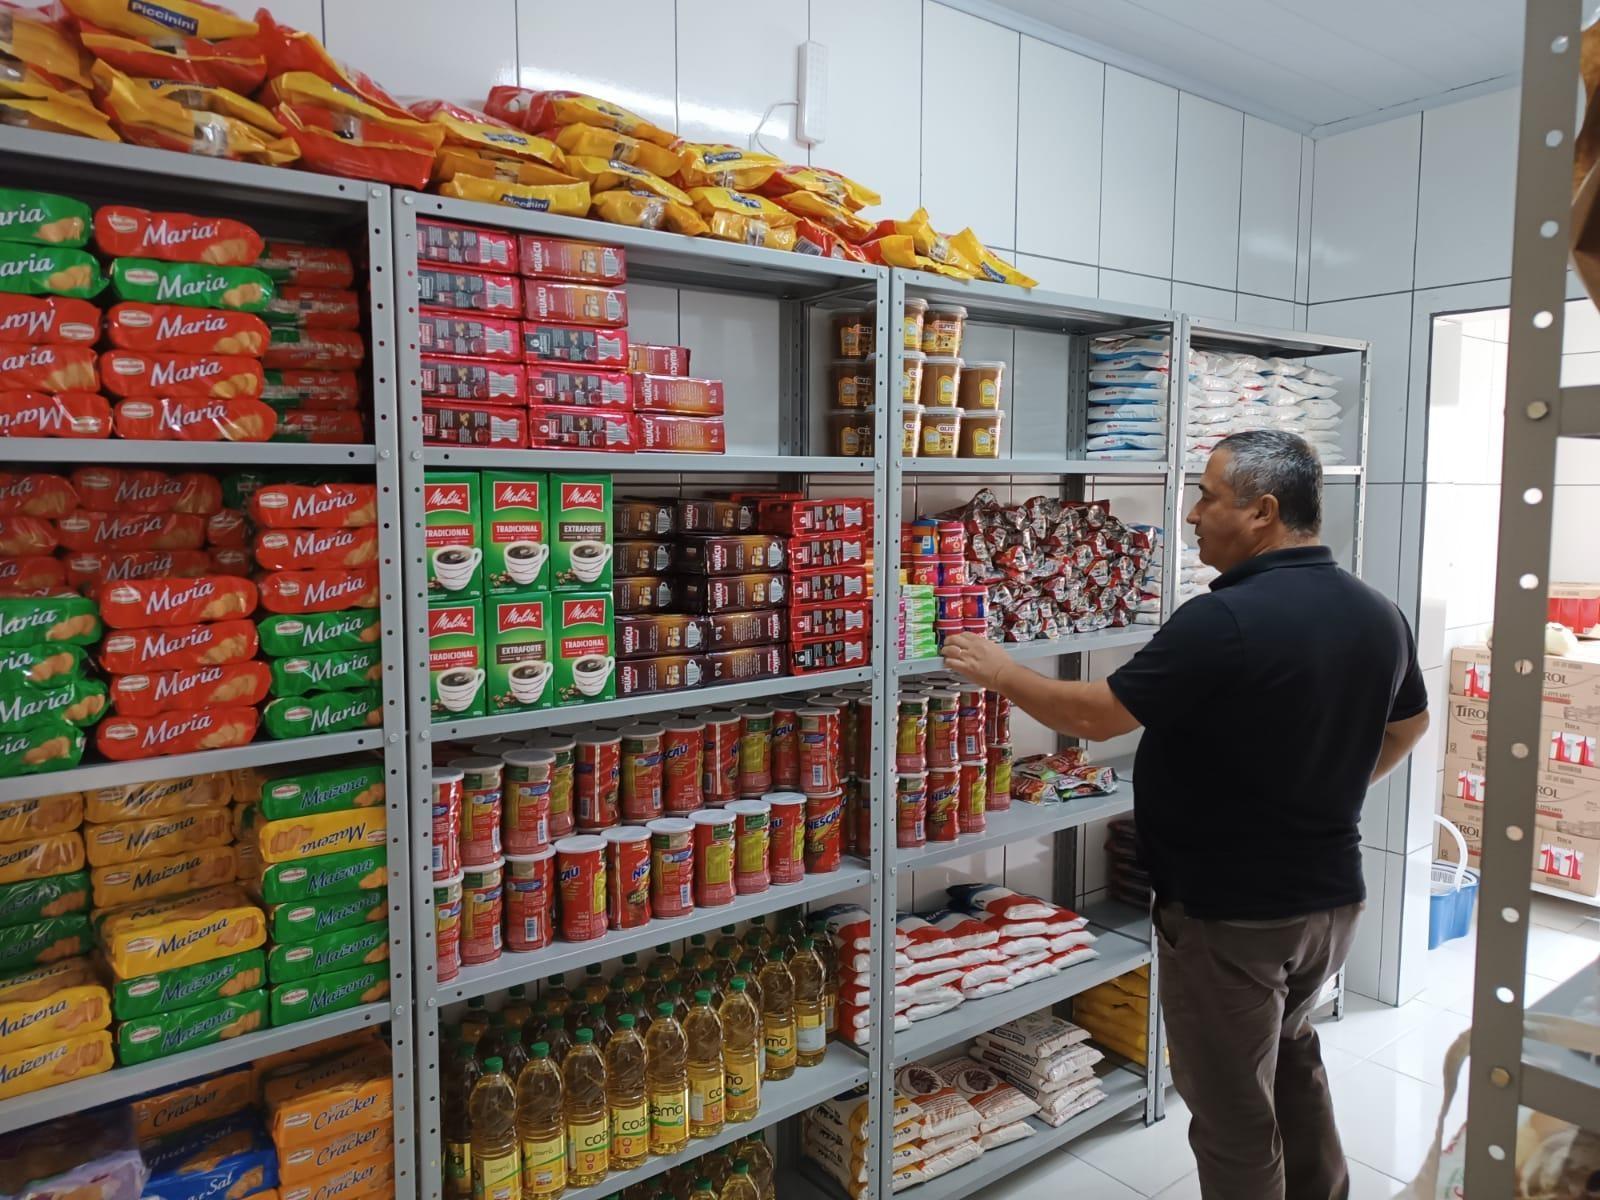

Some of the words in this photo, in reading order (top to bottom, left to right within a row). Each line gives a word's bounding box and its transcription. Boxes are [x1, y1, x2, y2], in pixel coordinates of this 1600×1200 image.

[131, 1, 195, 31] Piccinini
[0, 204, 45, 226] ria
[142, 219, 214, 247] Maria
[0, 253, 55, 277] aria
[157, 274, 228, 300] Maria
[156, 315, 228, 341] Maria
[0, 347, 54, 371] aria
[151, 359, 222, 387] Maria
[159, 401, 228, 431] Maria
[115, 479, 182, 502] Maria
[427, 487, 463, 506] Melitta
[498, 485, 533, 504] Melitta
[566, 486, 597, 504] Melitta
[292, 491, 357, 520] Maria
[94, 516, 162, 543] Maria
[425, 528, 470, 538] TRADICIONAL
[496, 525, 538, 533] TRADICIONAL
[564, 525, 602, 534] EXTRAFORTE
[293, 530, 356, 558] Maria
[106, 554, 172, 582] Maria
[146, 578, 215, 615] Maria
[304, 576, 366, 607] Maria
[0, 609, 57, 637] aria
[433, 612, 468, 631] Melitta
[504, 607, 537, 626] Melitta
[567, 603, 599, 622] Melitta
[141, 628, 213, 661] Maria
[303, 617, 364, 647] Maria
[565, 638, 605, 650] TRADICIONAL
[430, 650, 474, 661] TRADICIONAL
[502, 644, 543, 656] EXTRAFORTE
[312, 655, 369, 683] Maria
[1543, 671, 1568, 685] ROL
[155, 667, 223, 701] Maria
[142, 713, 213, 748] Maria
[311, 701, 369, 732] Maria
[663, 744, 688, 761] SCAU
[301, 776, 368, 810] Maizena
[1537, 786, 1560, 799] ROL
[302, 822, 367, 853] Maizena
[132, 857, 202, 891] Maizena
[308, 859, 374, 894] Maizena
[316, 892, 379, 932] Maizena
[157, 918, 229, 958] Maizena
[314, 935, 377, 971] Maizena
[161, 964, 234, 1008] Maizena
[310, 974, 374, 1013] Maizena
[162, 1007, 235, 1053] Maizena
[153, 1090, 218, 1128] Cracker
[314, 1094, 378, 1131] Cracker
[585, 1130, 609, 1147] coa
[622, 1117, 647, 1132] coa
[317, 1127, 379, 1166] Cracker
[207, 1166, 238, 1195] Sal
[314, 1165, 377, 1200] Cracker
